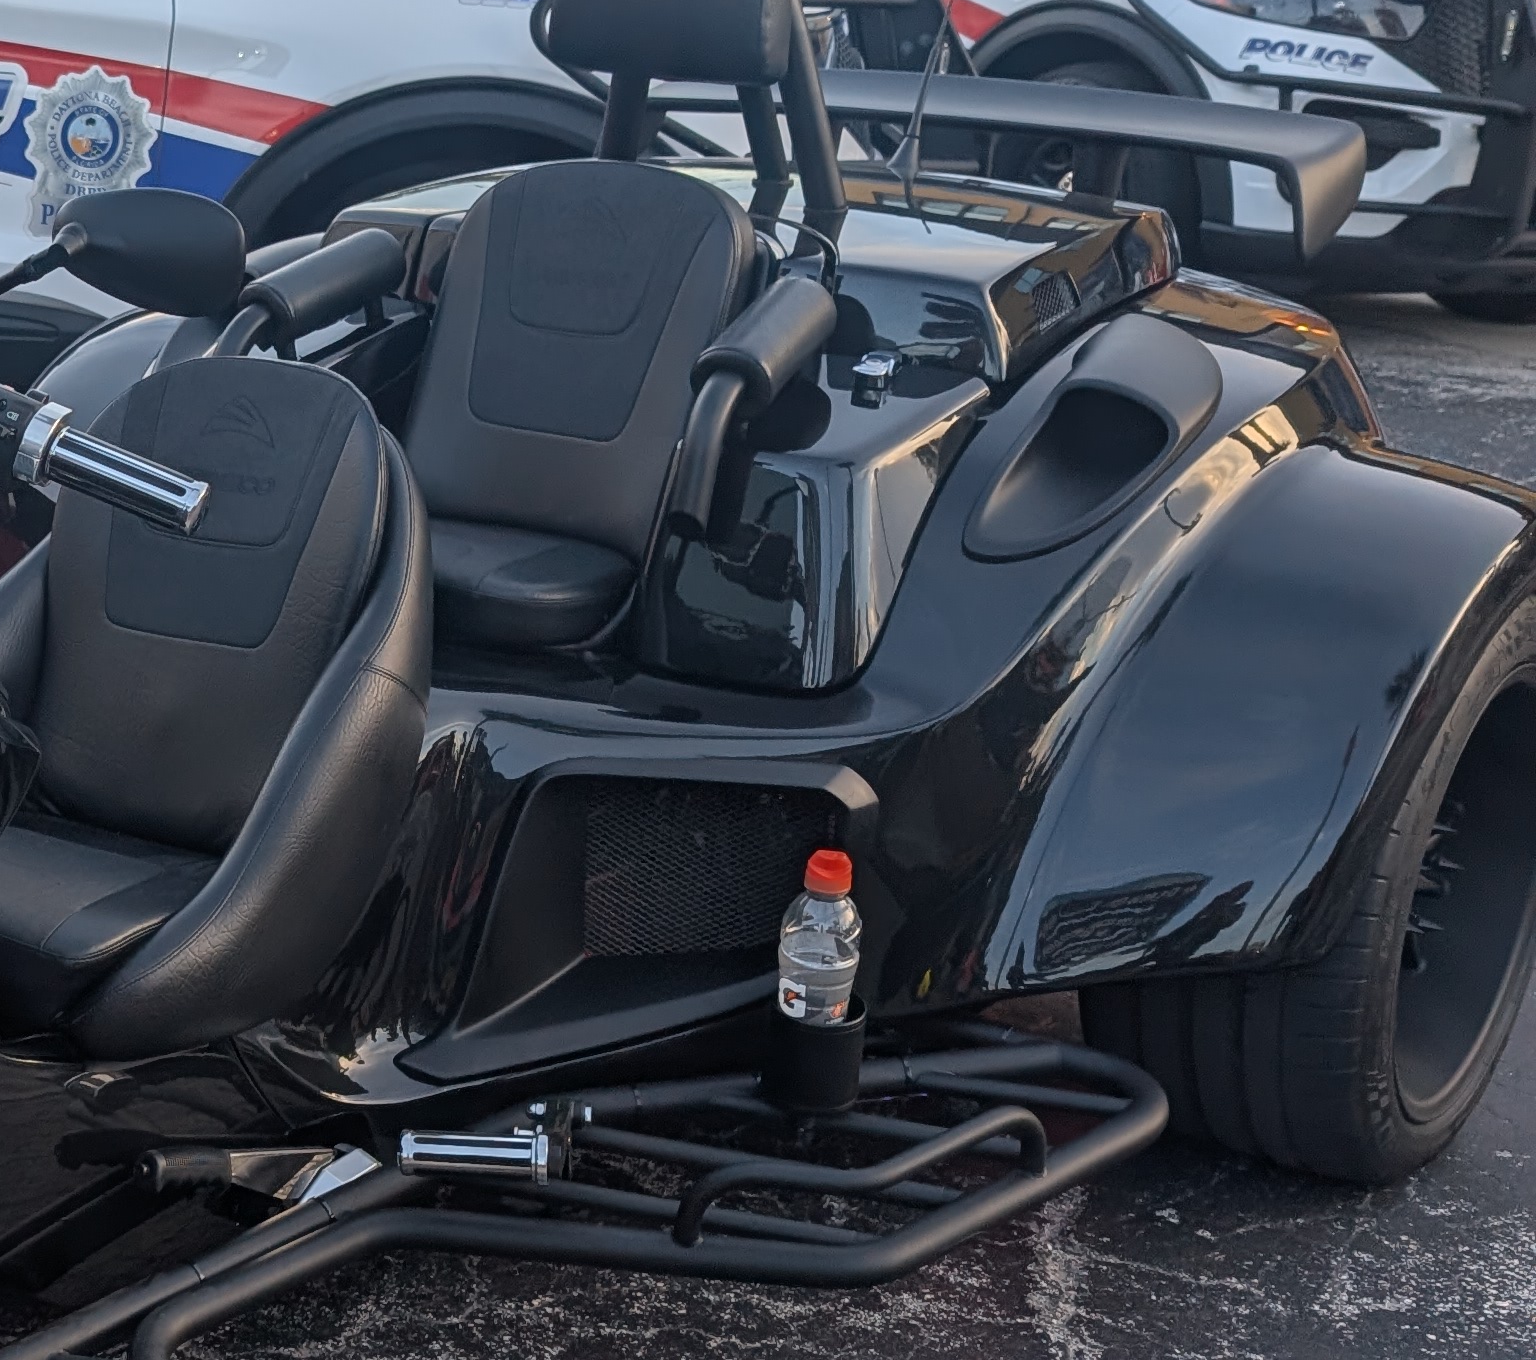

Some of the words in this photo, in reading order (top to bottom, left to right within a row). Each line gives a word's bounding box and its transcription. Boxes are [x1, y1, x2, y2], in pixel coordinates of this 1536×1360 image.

[1239, 37, 1374, 76] POLICE
[52, 91, 100, 122] DAYTONA
[103, 94, 132, 128] BEACH
[48, 133, 71, 173] POLICE
[71, 140, 133, 181] DEPARTMENT
[778, 977, 806, 1019] G
